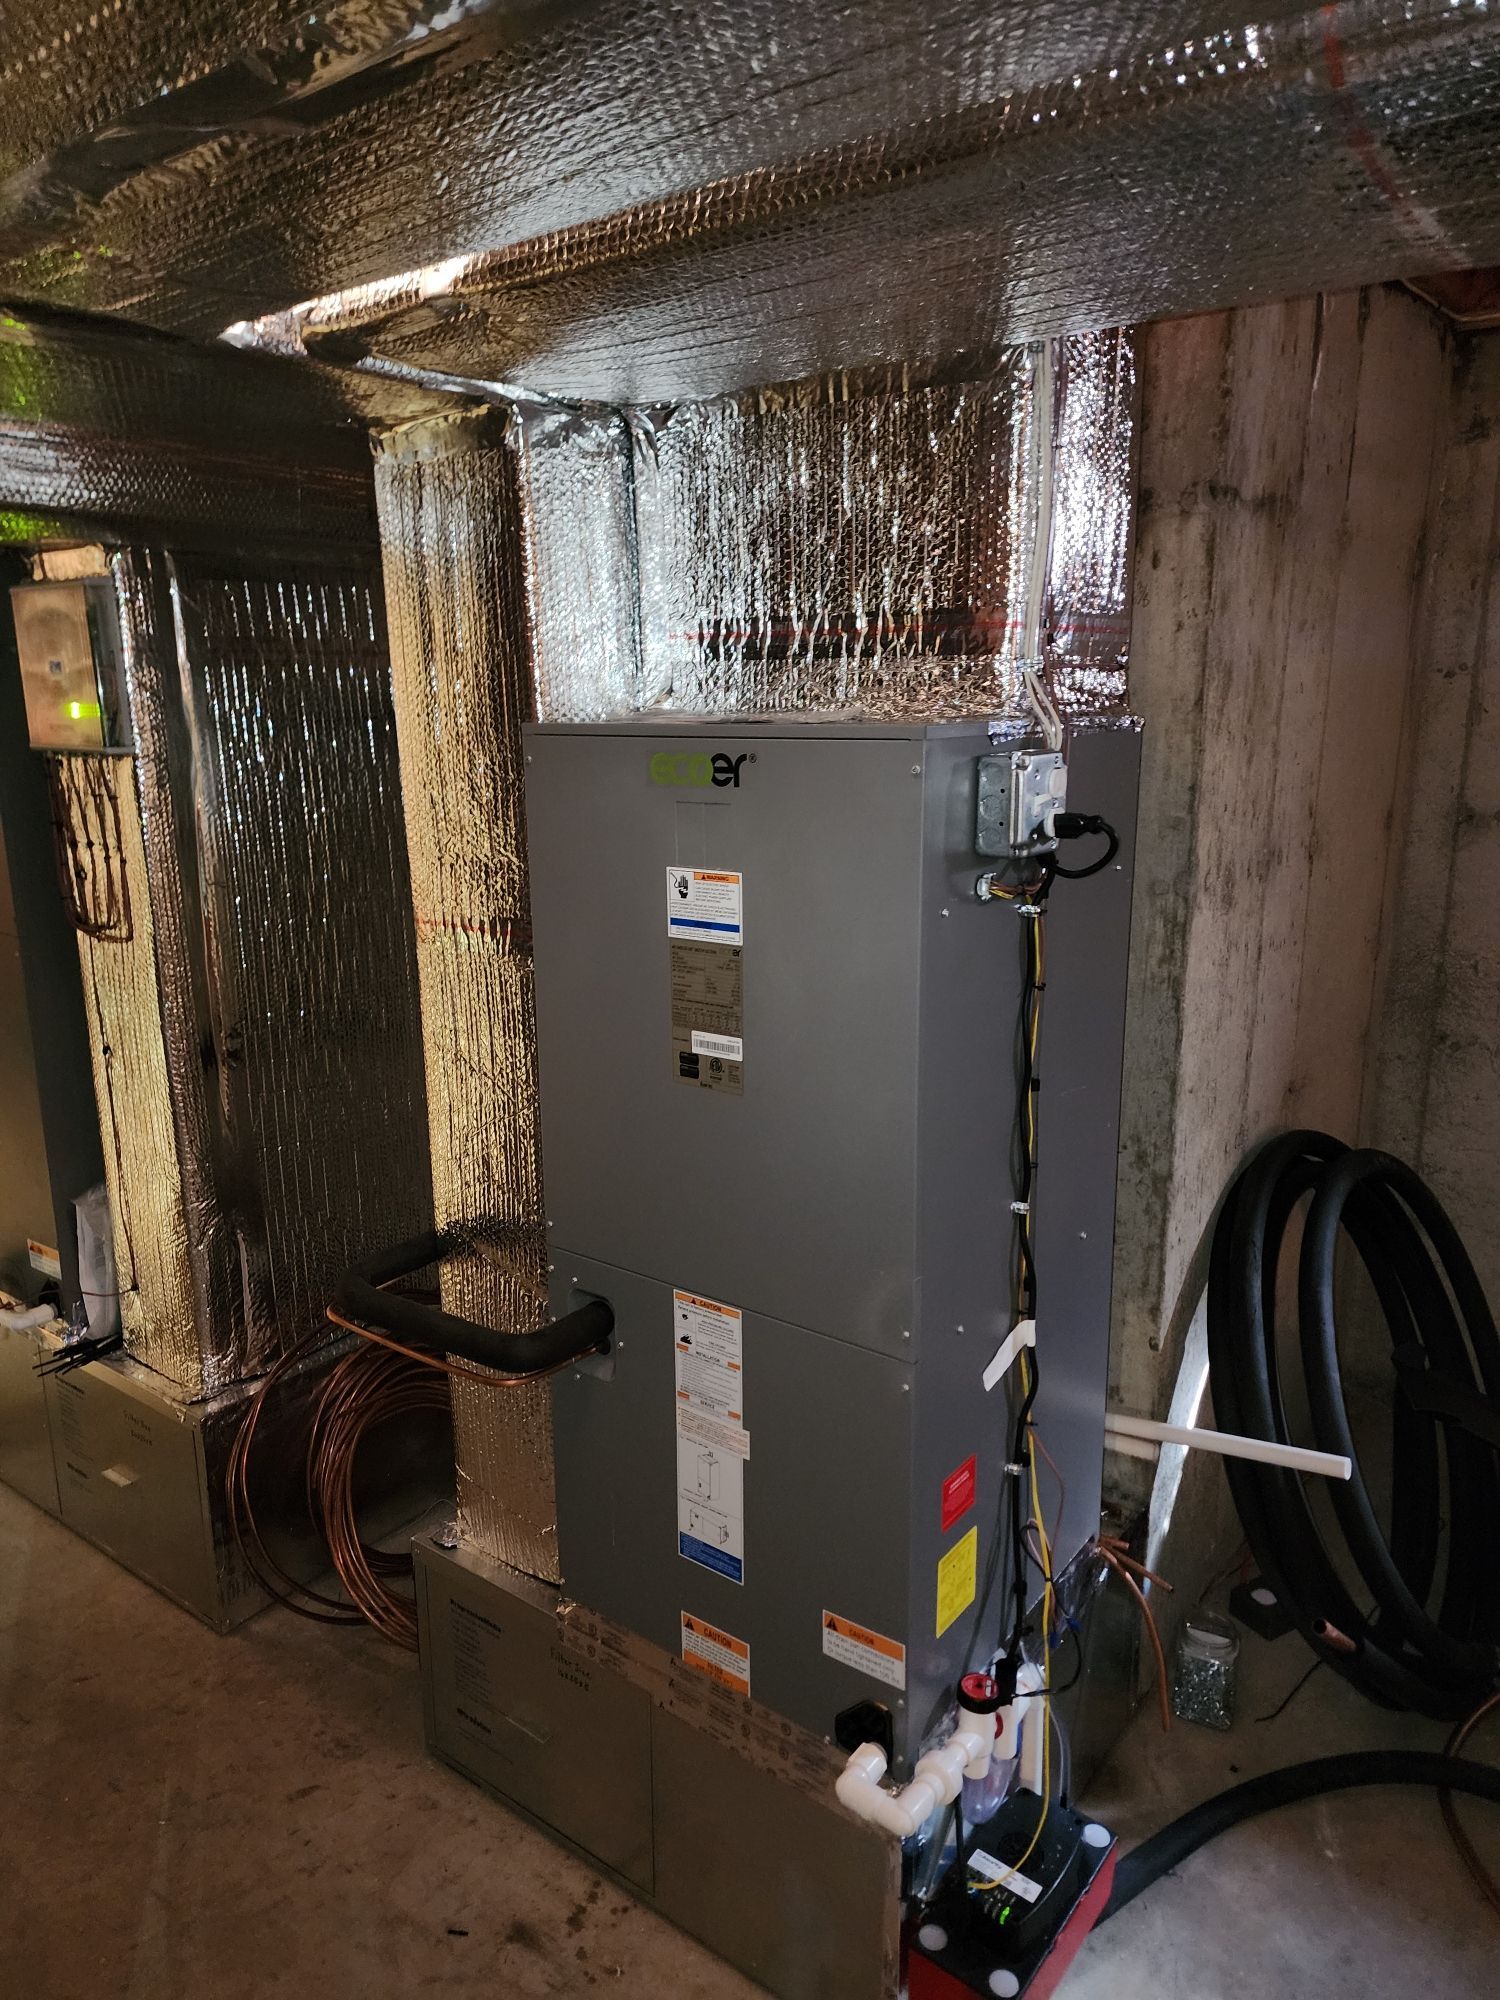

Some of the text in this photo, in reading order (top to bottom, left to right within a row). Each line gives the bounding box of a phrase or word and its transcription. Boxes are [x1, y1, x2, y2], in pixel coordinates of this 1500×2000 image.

[699, 1300, 722, 1312] CAUTION
[703, 1627, 732, 1649] CAUTION
[848, 1629, 875, 1645] CAUTION
